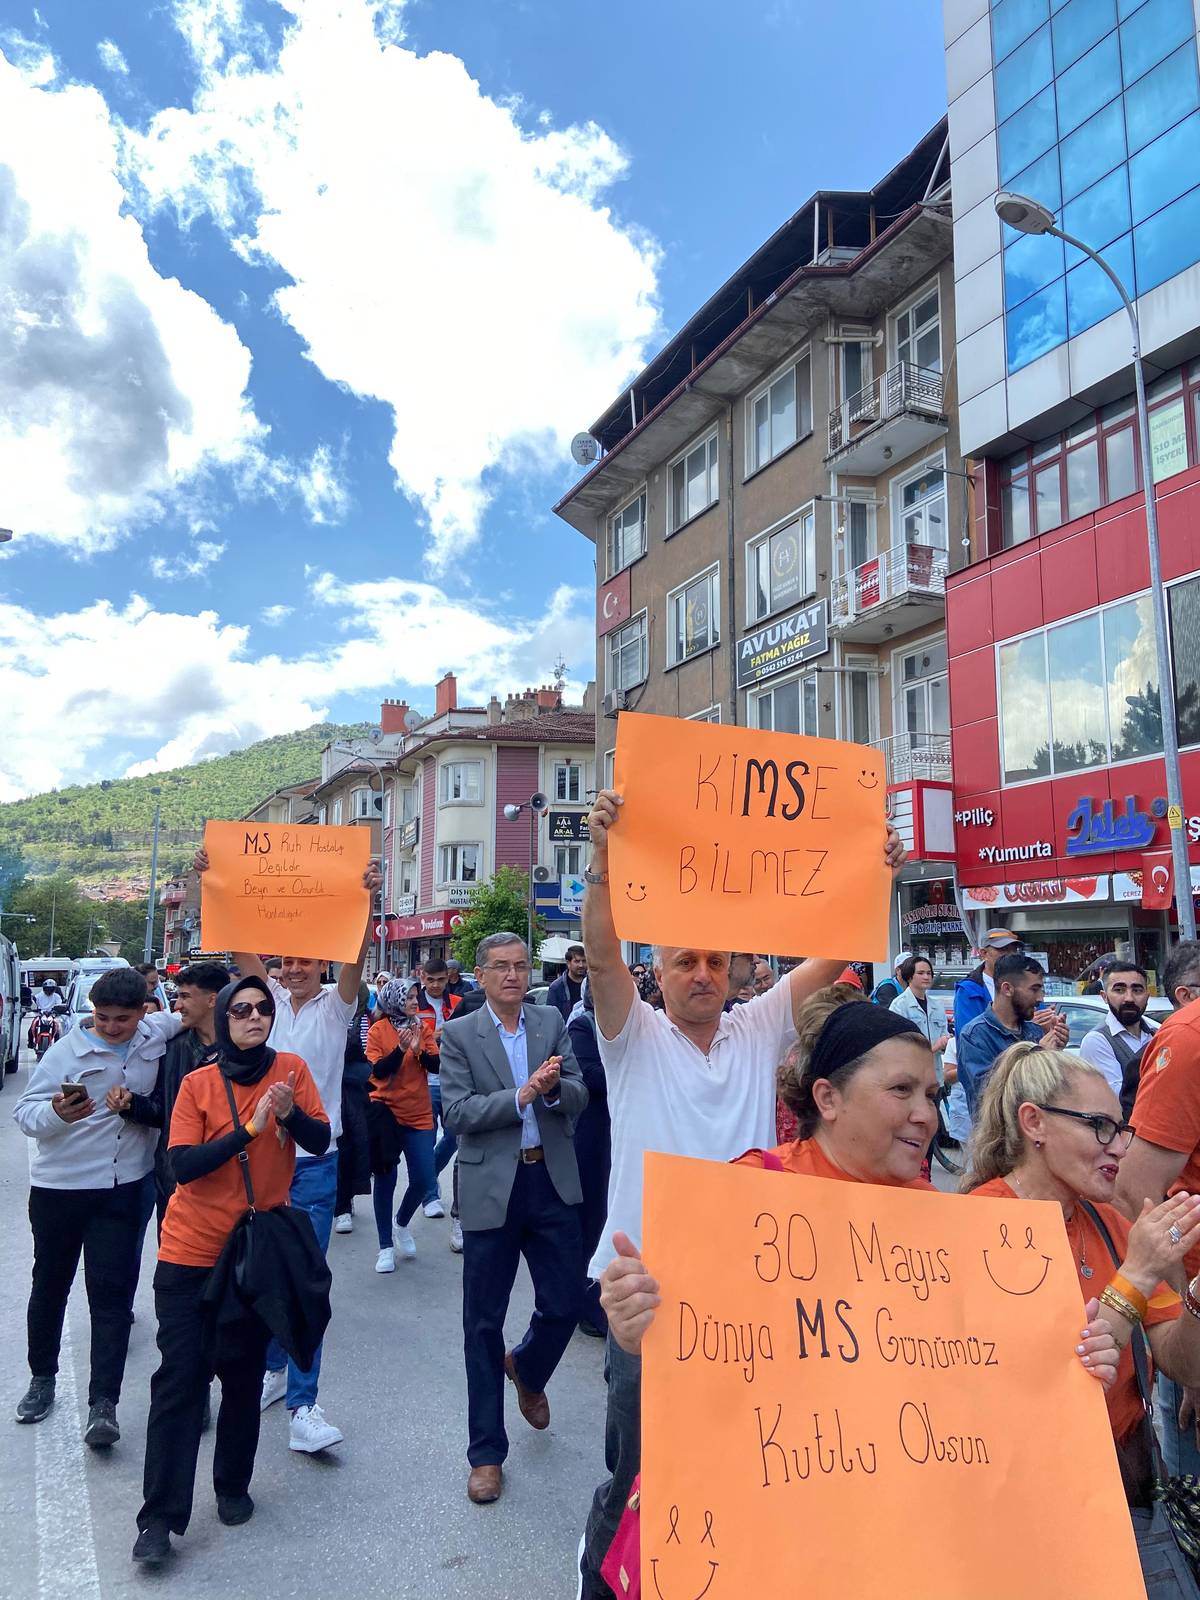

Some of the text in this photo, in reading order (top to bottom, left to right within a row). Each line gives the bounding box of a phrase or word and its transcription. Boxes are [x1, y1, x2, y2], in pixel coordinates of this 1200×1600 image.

[741, 605, 821, 660] AVUKAT
[751, 633, 810, 668] FATMA YAĞIZ
[761, 663, 776, 675] 0542
[696, 753, 838, 821] KİMSE
[244, 832, 271, 855] MS
[281, 832, 302, 851] Ruh
[679, 842, 829, 896] BİLMEZ
[942, 921, 964, 933] MARKE
[753, 1212, 951, 1301] 30 Mayıs
[676, 1297, 999, 1383] Dünya MS Günümüz
[754, 1401, 990, 1488] Kutlu Olsun
